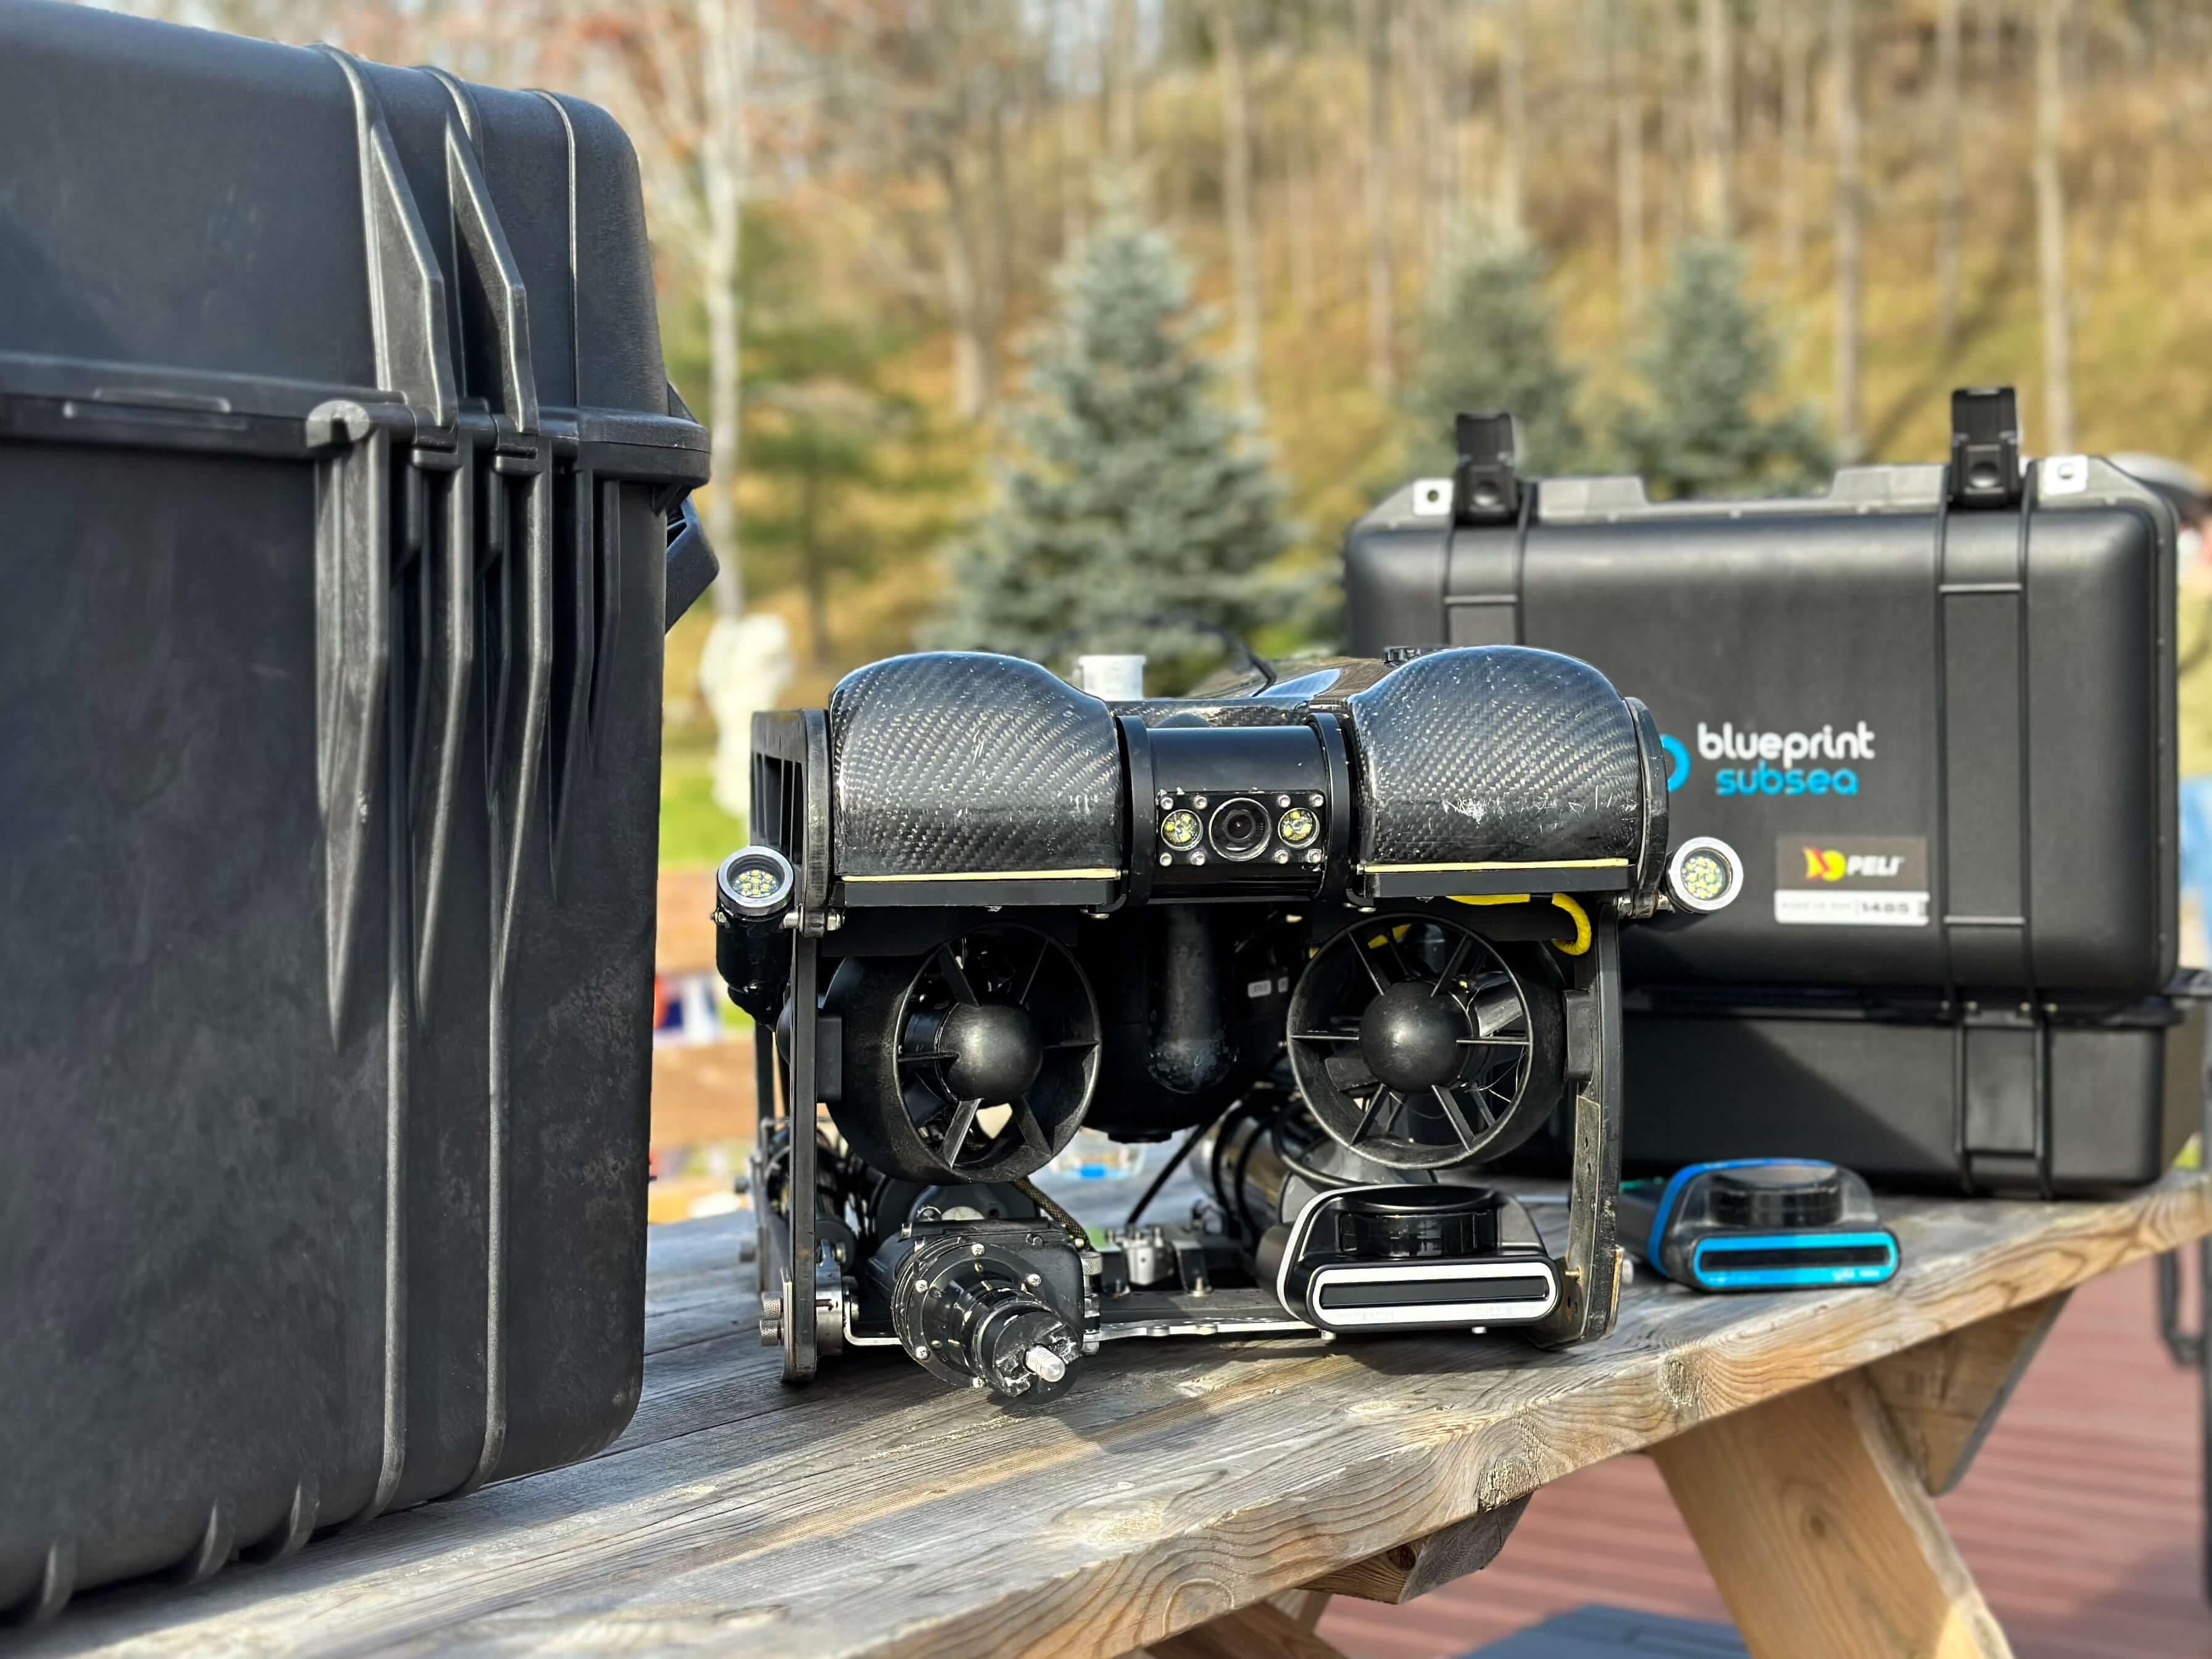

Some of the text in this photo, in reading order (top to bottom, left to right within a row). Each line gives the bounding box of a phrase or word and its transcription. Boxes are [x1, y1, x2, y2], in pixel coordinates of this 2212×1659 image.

[1698, 721, 1875, 769] blueprint
[1715, 759, 1859, 796] subsea
[1846, 855, 1901, 876] PELI
